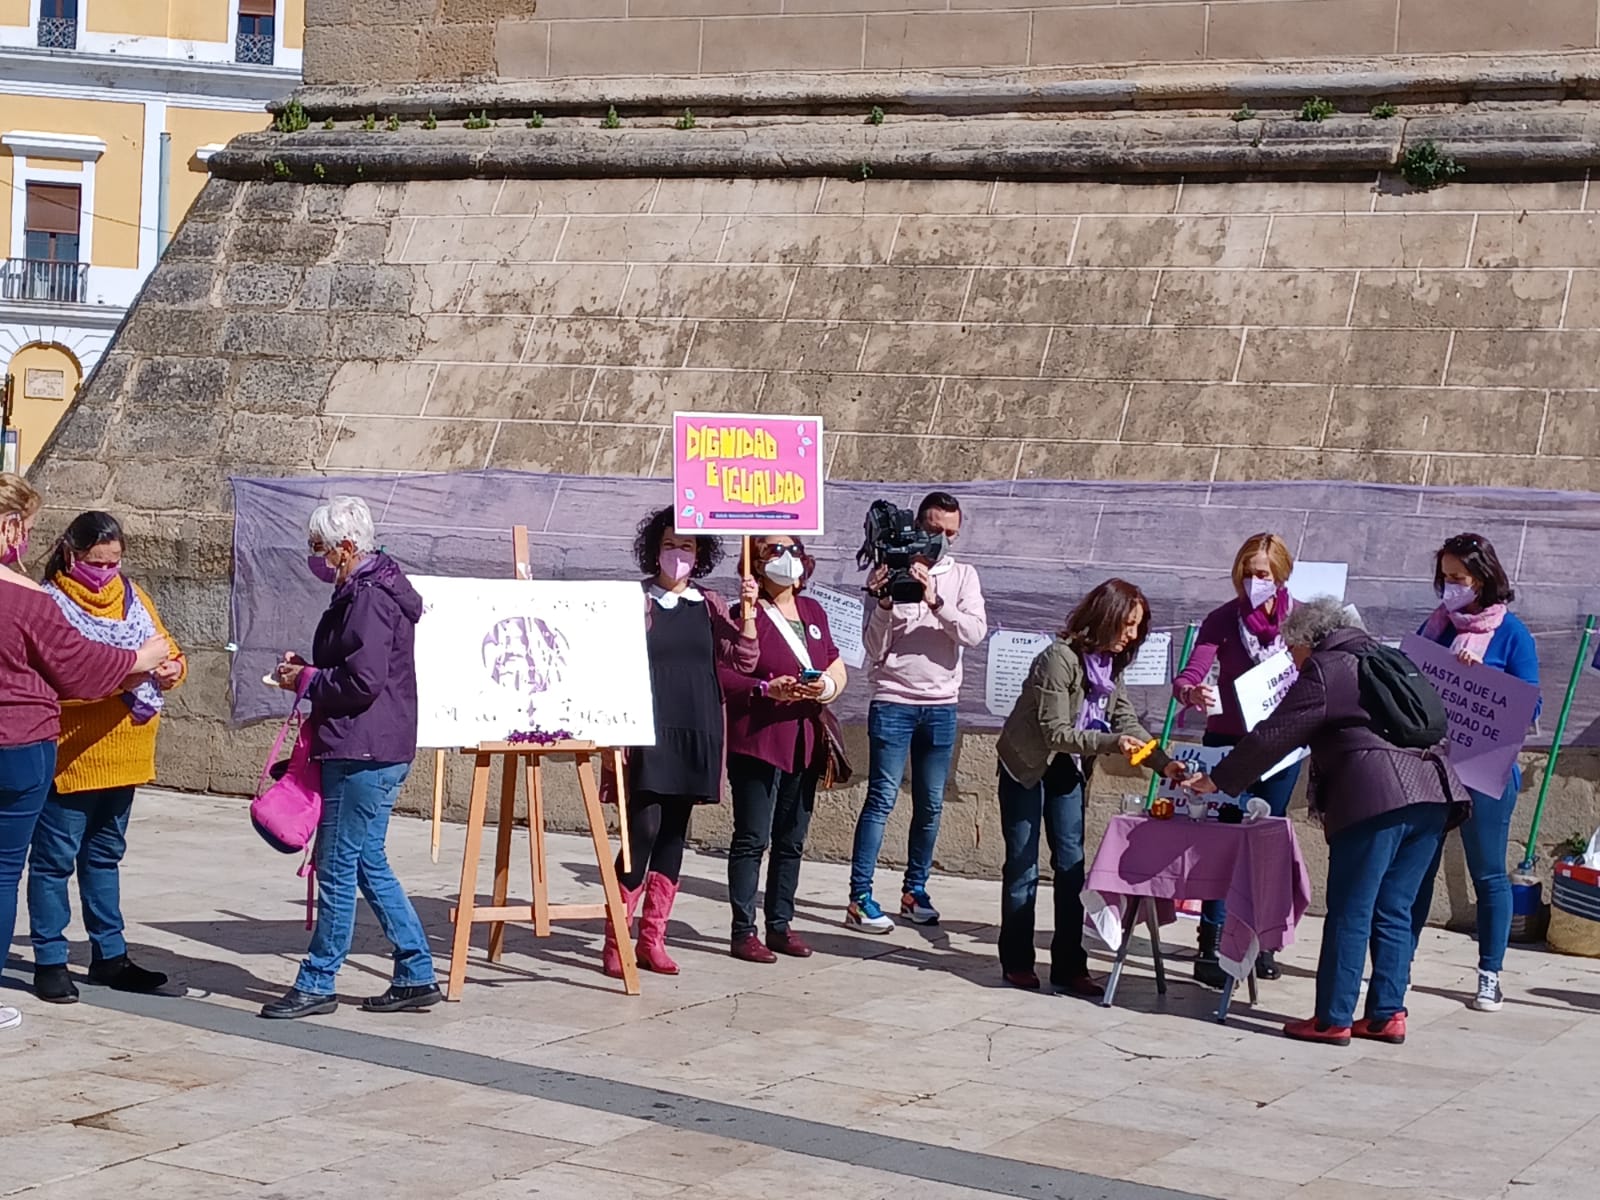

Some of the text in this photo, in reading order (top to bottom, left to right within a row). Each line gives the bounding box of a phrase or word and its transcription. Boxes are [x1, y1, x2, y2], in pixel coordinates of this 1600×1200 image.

[686, 423, 777, 461] DIGNIDAD
[706, 461, 805, 507] E IGUALDAD
[1422, 661, 1507, 708] HASTA QUE LA
[1471, 702, 1495, 721] SEA
[1481, 725, 1501, 742] DE
